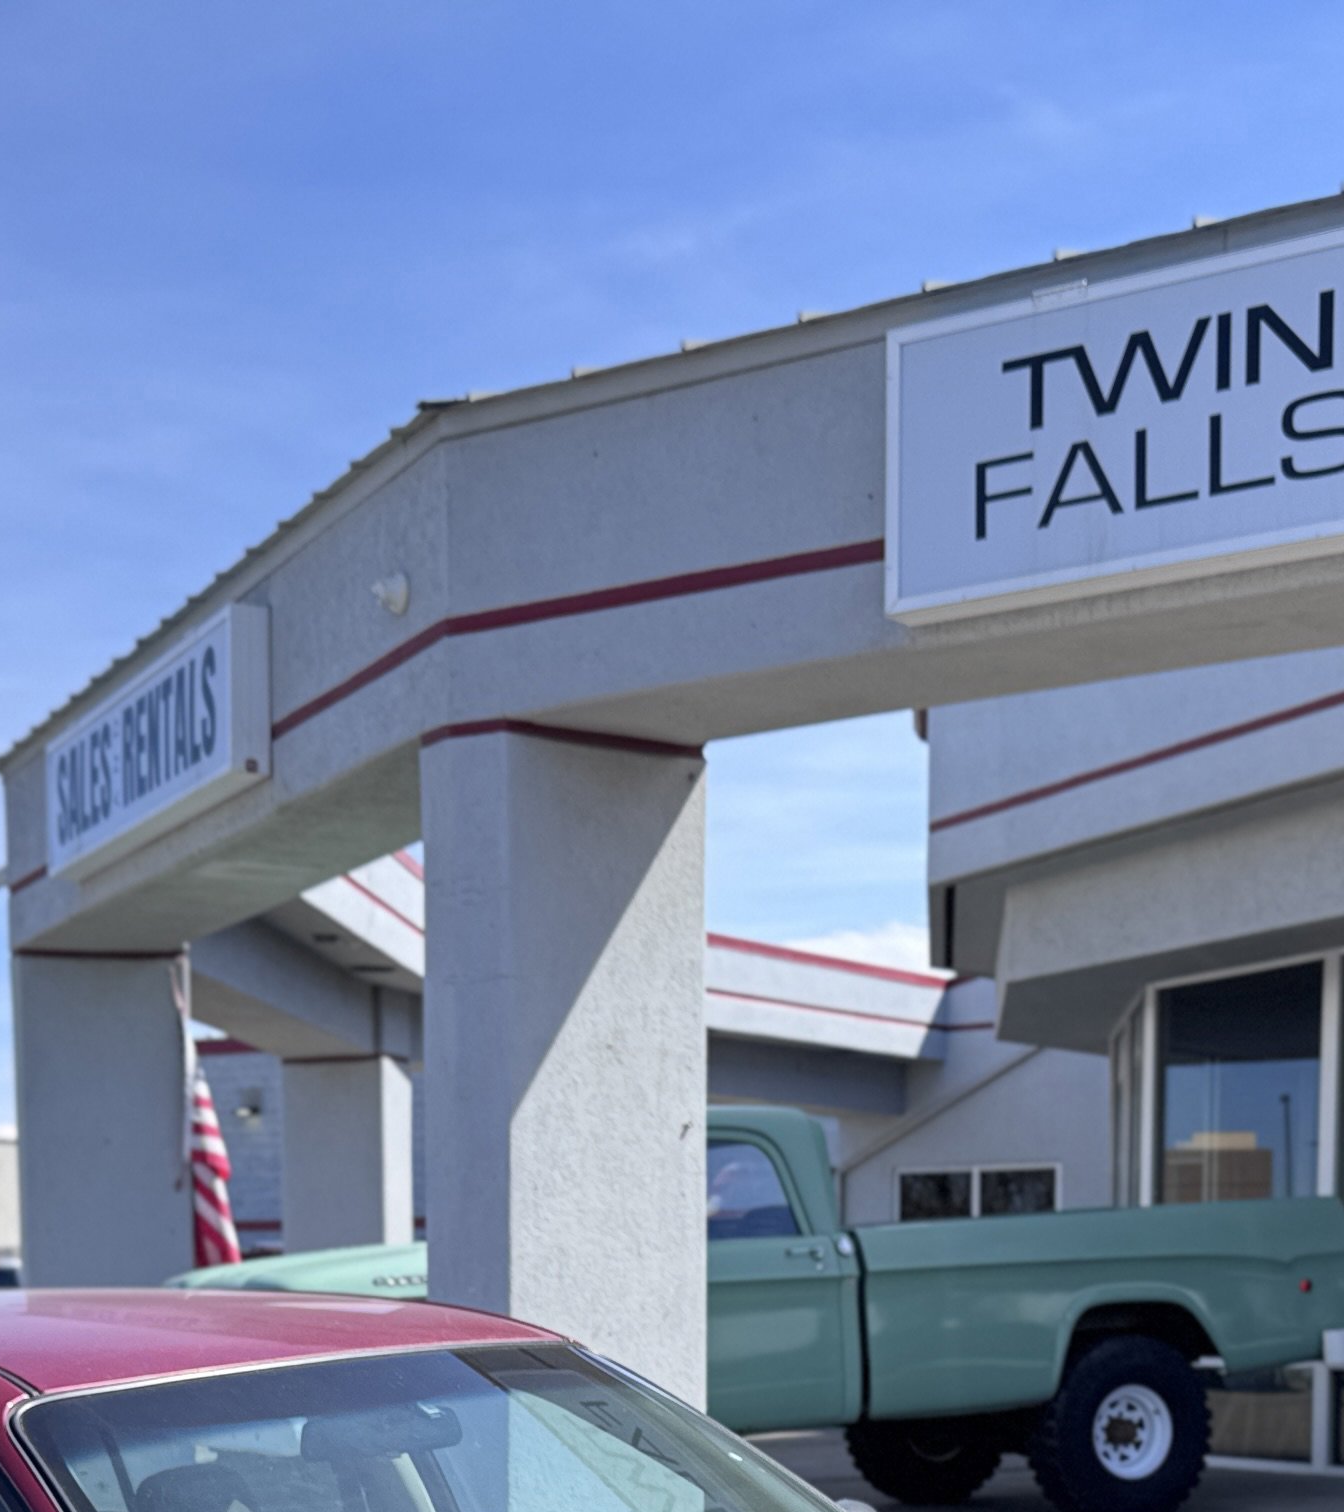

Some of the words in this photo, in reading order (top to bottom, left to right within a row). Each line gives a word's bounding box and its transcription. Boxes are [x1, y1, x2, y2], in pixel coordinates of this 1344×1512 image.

[1001, 289, 1334, 431] TWIN
[58, 722, 112, 846] SALES
[122, 645, 217, 808] RENTALS
